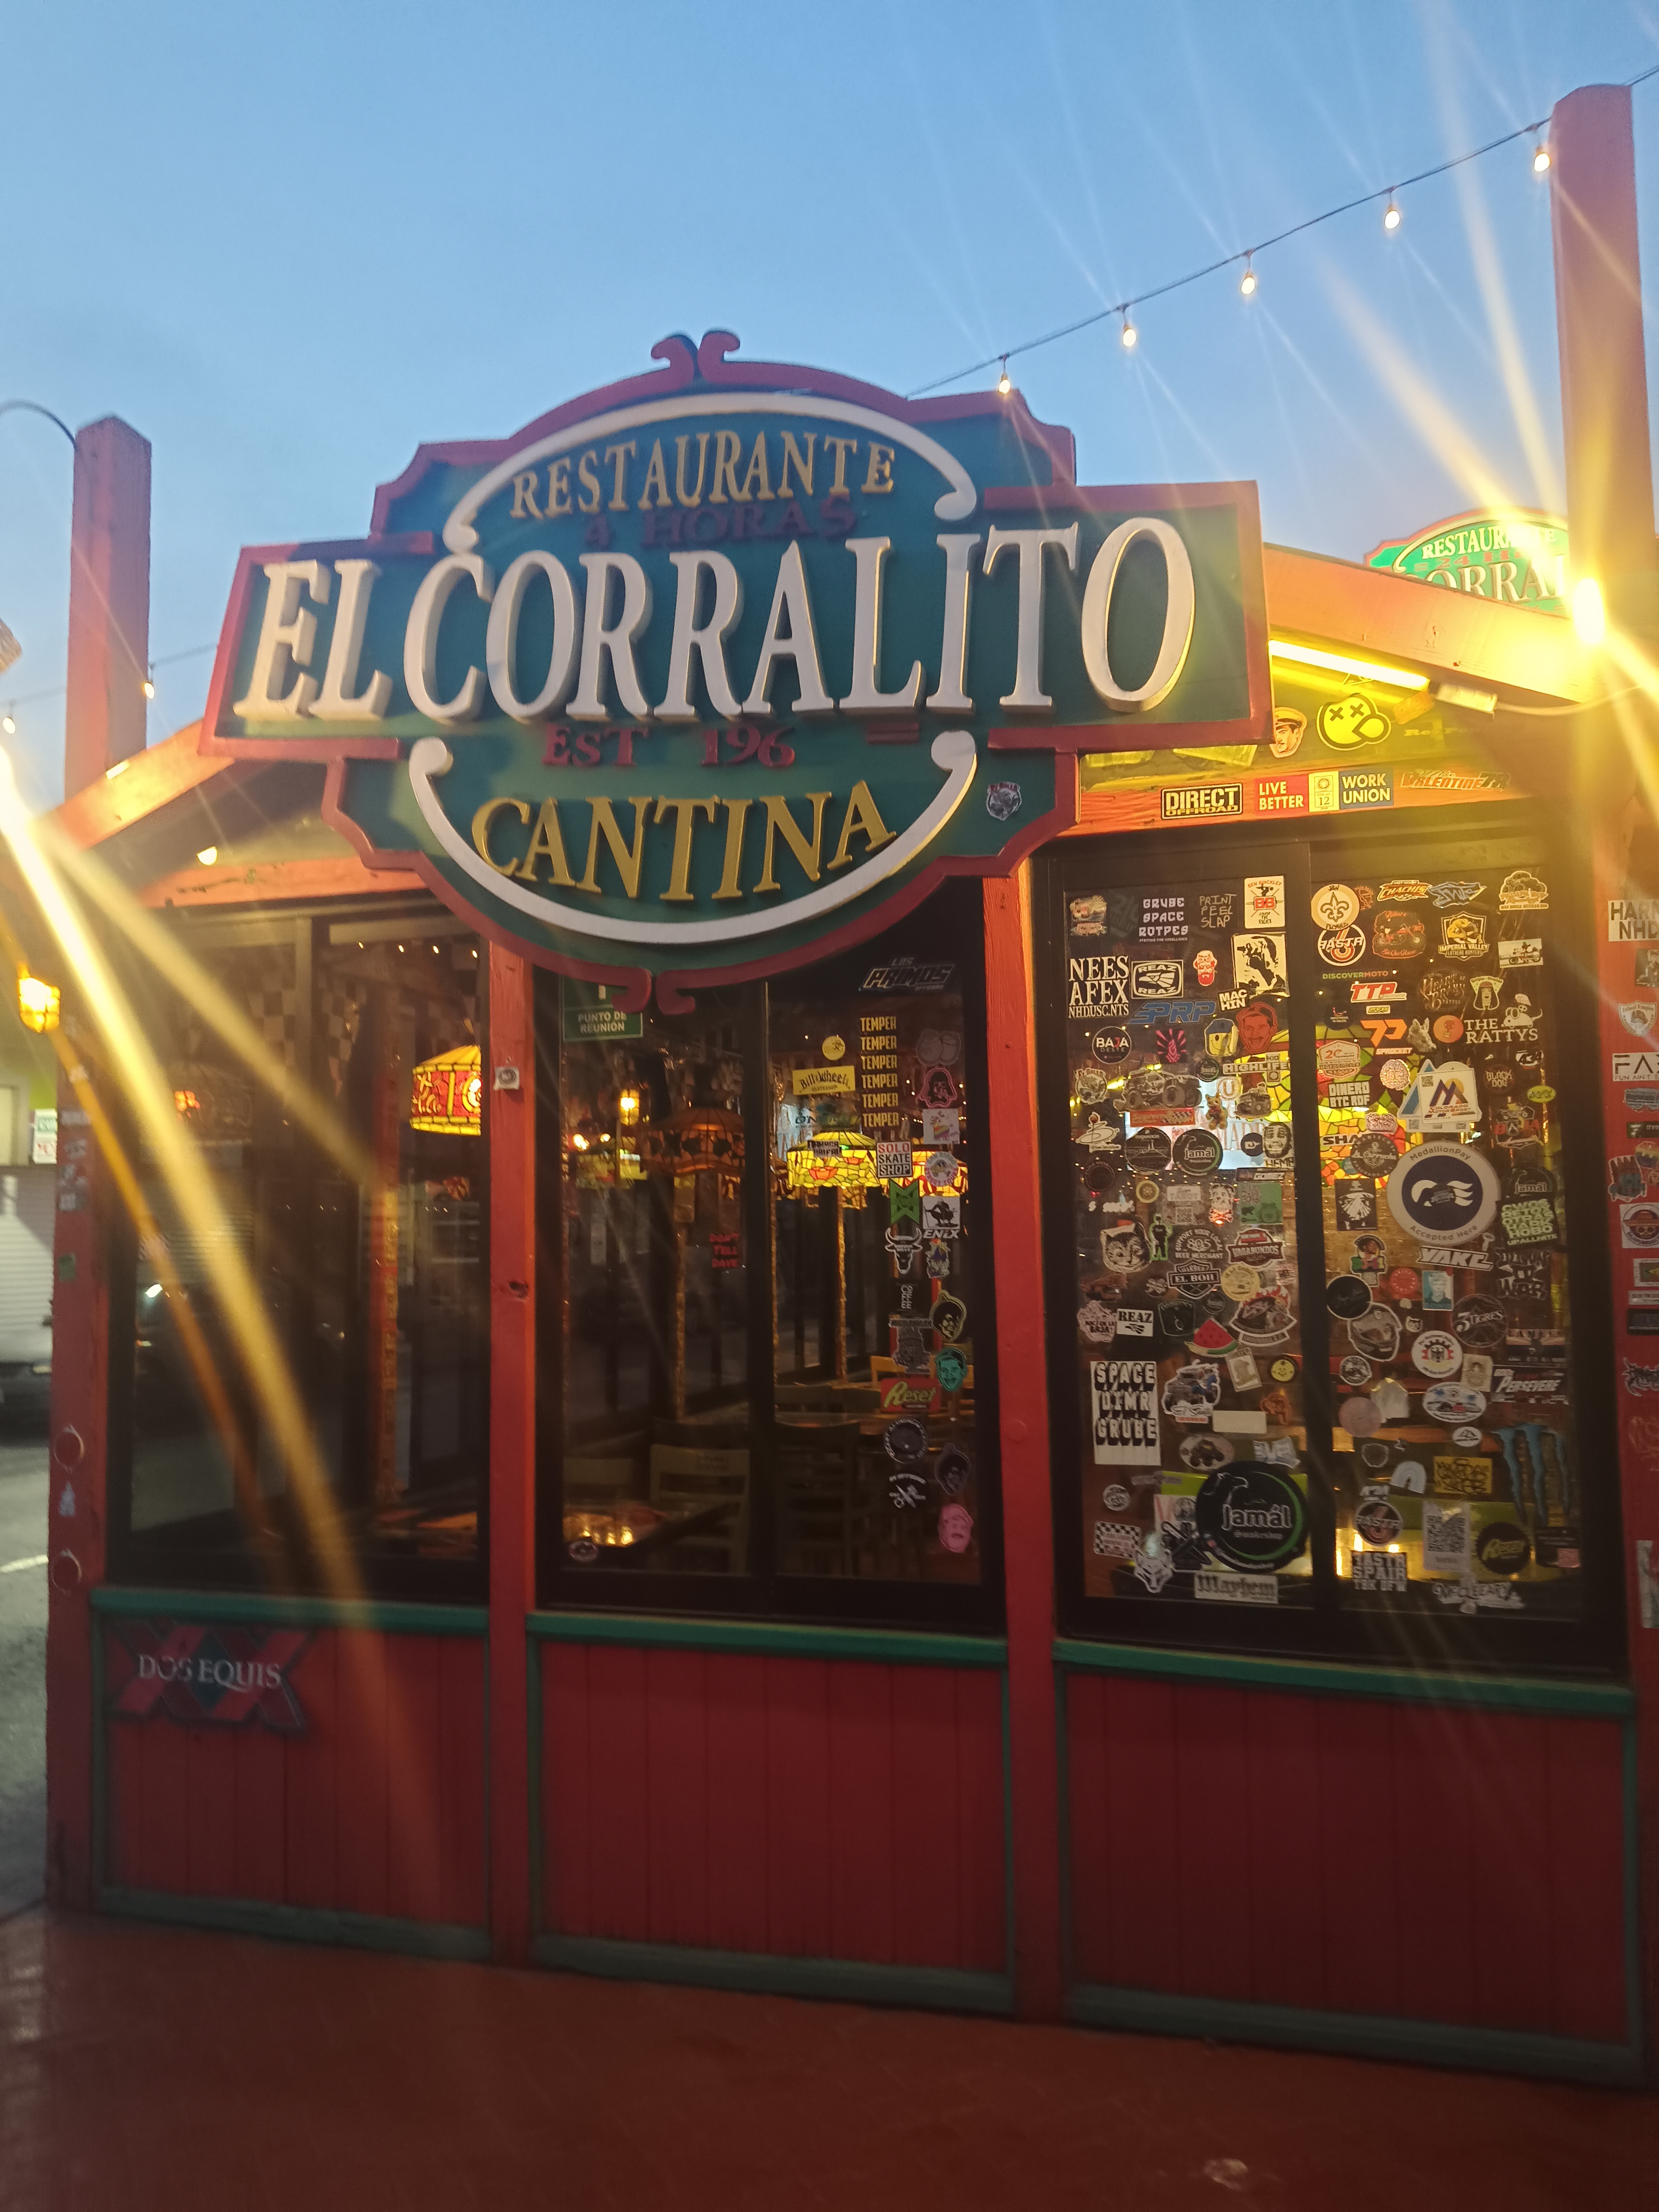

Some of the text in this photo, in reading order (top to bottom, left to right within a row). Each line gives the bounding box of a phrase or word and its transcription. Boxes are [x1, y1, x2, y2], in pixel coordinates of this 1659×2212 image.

[510, 430, 895, 520] RESTAURANTE
[641, 493, 857, 547] HORAS
[233, 516, 1197, 723] EL CORRALITO
[541, 722, 795, 768] EST 196
[1343, 773, 1386, 788] WORK
[1259, 781, 1287, 796] LIVE
[1166, 787, 1238, 811] DIRECT
[1259, 793, 1304, 811] BETTER
[1319, 796, 1330, 806] 12
[1343, 788, 1391, 804] UNION
[1166, 805, 1238, 816] OFFROAD
[471, 780, 899, 901] CANTINA
[1143, 897, 1185, 909] GRUBE
[1143, 911, 1184, 923] SPACE
[1201, 905, 1233, 916] PEEL
[1200, 915, 1231, 928] SLAP
[1069, 955, 1129, 982] NEES
[1138, 964, 1177, 973] REAZ
[1322, 970, 1389, 980] DISCOVERMOTO
[1069, 979, 1129, 1006] AFEX
[1138, 986, 1177, 995] REAZ
[1352, 983, 1396, 1000] TTP
[578, 1011, 611, 1023] PUNTO
[1464, 1018, 1498, 1031] THE
[1096, 1037, 1130, 1048] BAJA
[1466, 1028, 1539, 1044] RATTYS
[1375, 1047, 1413, 1055] SPROCKET
[1224, 1062, 1287, 1073] HIGHLIFE
[1330, 1095, 1349, 1107] BTC
[878, 1142, 910, 1153] SOLO
[878, 1153, 911, 1164] SKATE
[880, 1165, 910, 1176] SHOP
[1409, 1225, 1479, 1241] Accepted Here
[1187, 1238, 1212, 1250] 805
[1118, 1310, 1153, 1323] REAZ
[1095, 1362, 1156, 1386] SPACE
[1096, 1418, 1157, 1442] GRUBE
[138, 1654, 283, 1693] DOS EQUIS
